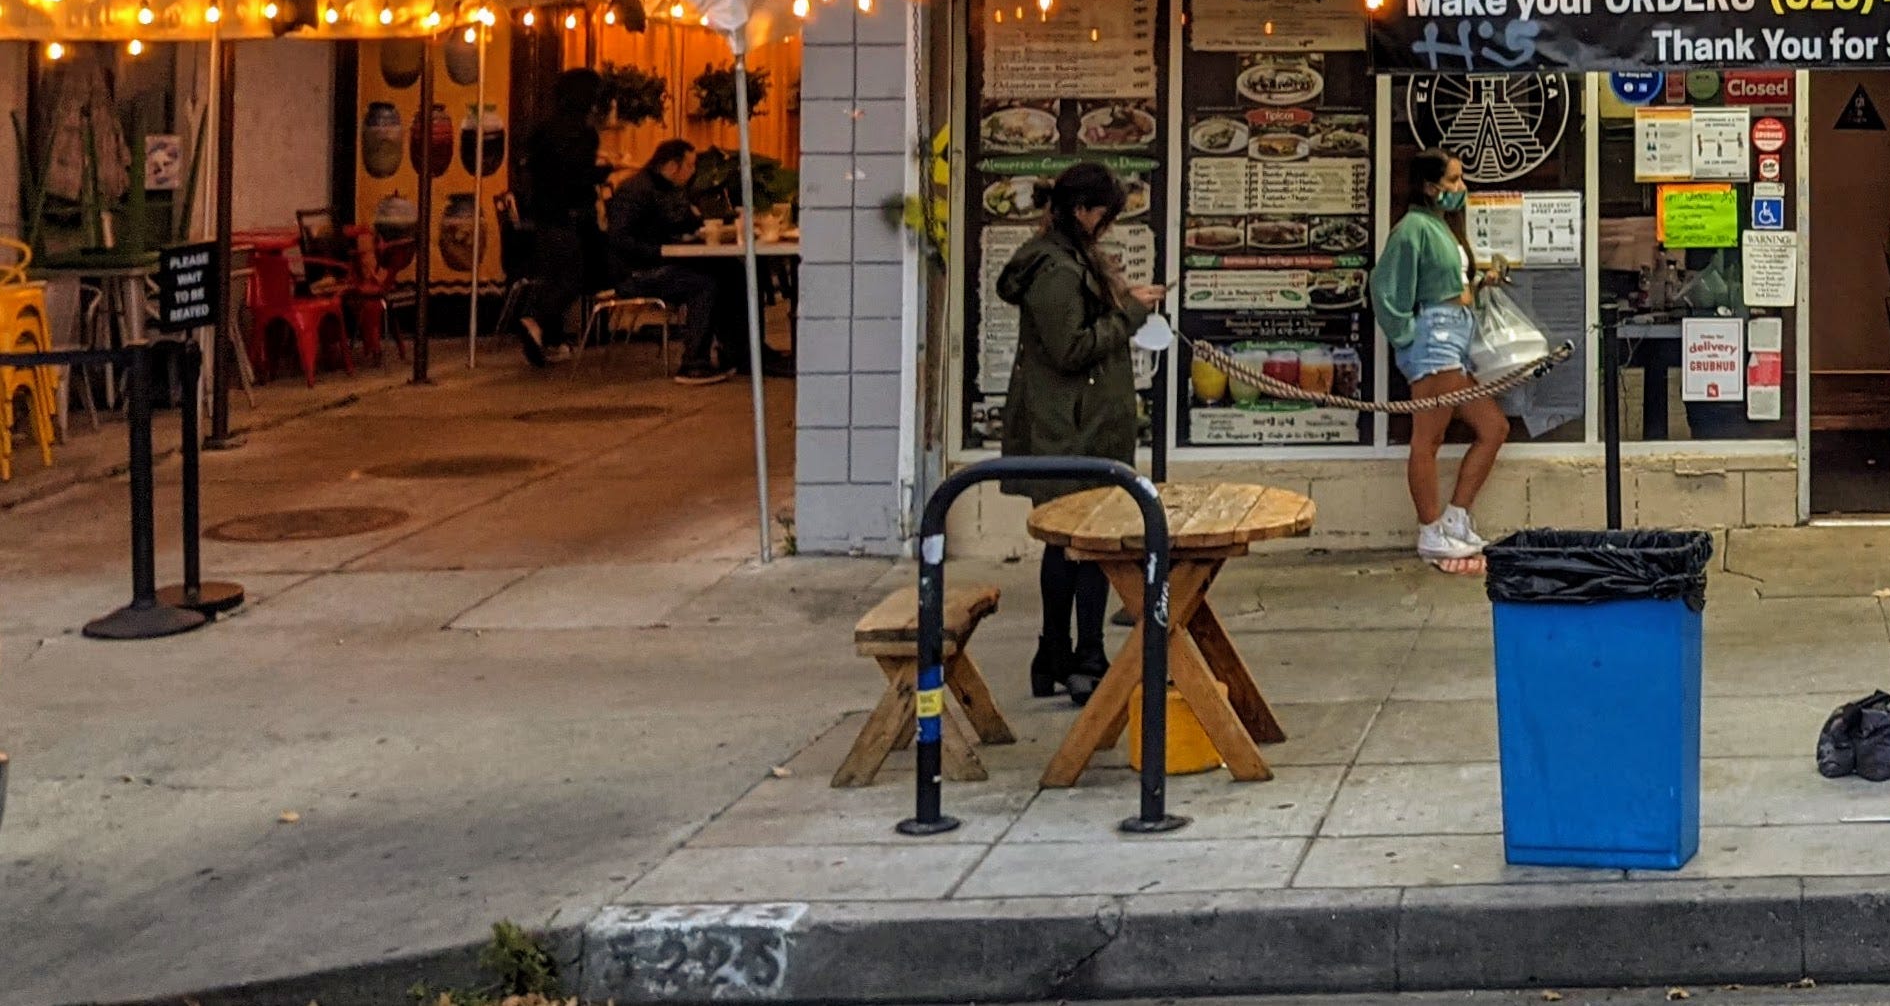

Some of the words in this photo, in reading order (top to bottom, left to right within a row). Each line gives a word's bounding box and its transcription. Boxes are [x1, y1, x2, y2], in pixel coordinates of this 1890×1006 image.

[1651, 28, 1752, 63] Thank
[1761, 28, 1823, 62] You
[1829, 26, 1878, 60] for
[1727, 77, 1789, 96] Closed
[169, 251, 210, 270] PLEASE
[177, 270, 203, 286] WAIT
[174, 290, 189, 304] TO
[190, 287, 205, 301] BE
[169, 303, 210, 322] SEATED
[1688, 341, 1738, 355] delivery
[1689, 360, 1736, 372] GRUBHUB
